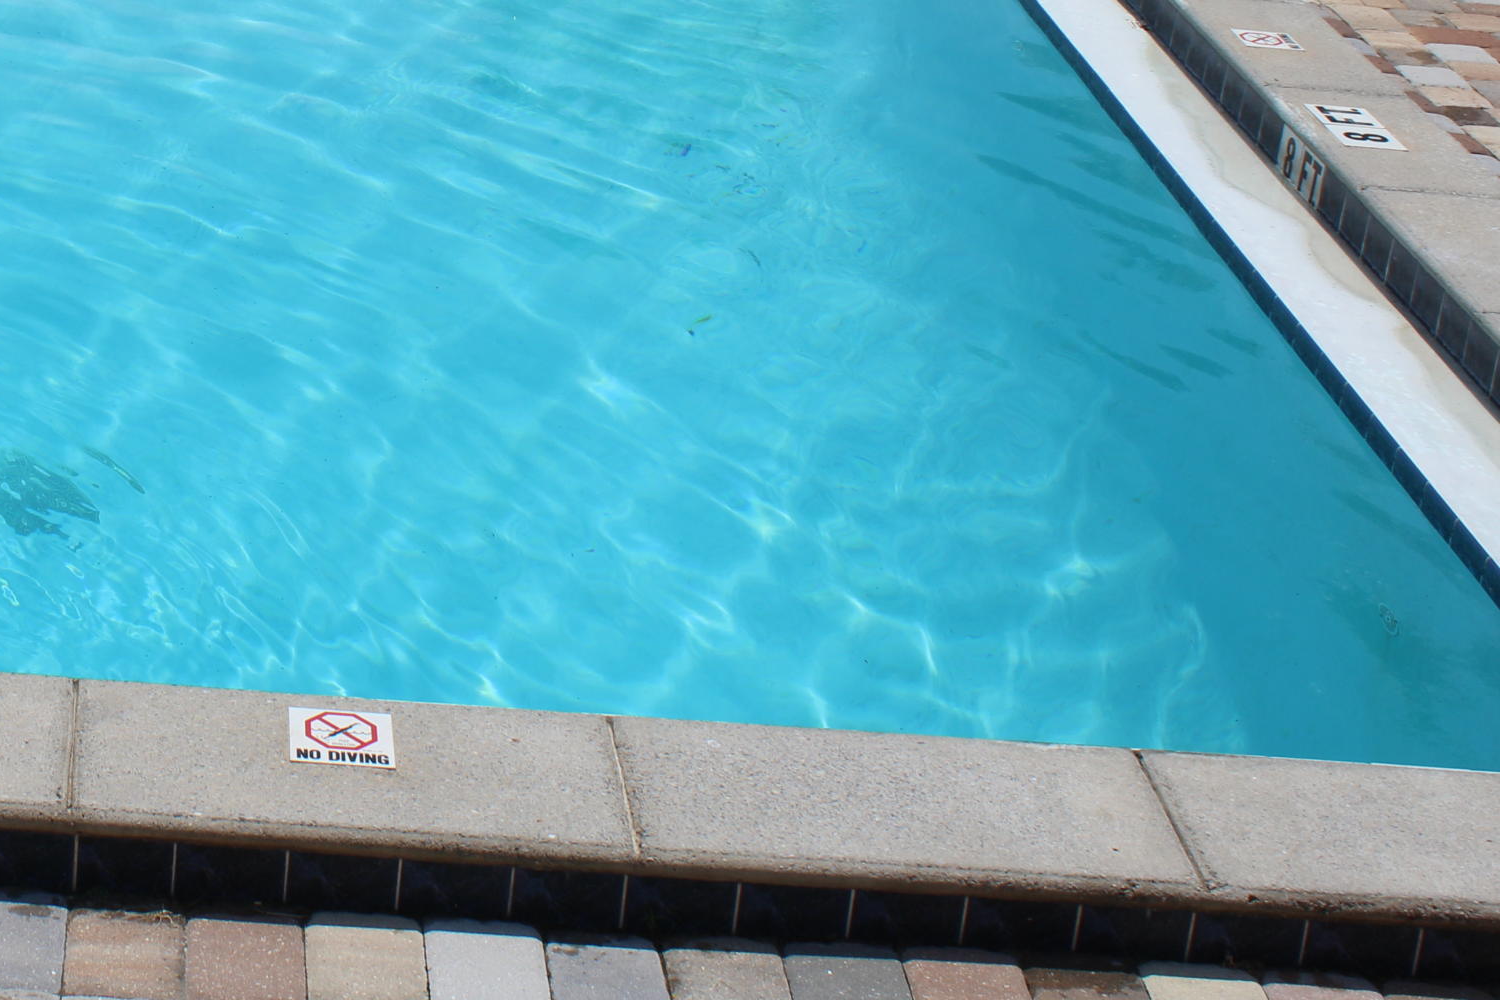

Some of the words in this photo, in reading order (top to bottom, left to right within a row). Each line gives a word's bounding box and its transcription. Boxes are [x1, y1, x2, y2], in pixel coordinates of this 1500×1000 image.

[1342, 131, 1389, 143] 8
[1282, 136, 1297, 179] 8
[296, 747, 321, 760] NO
[328, 749, 390, 766] DIVING
